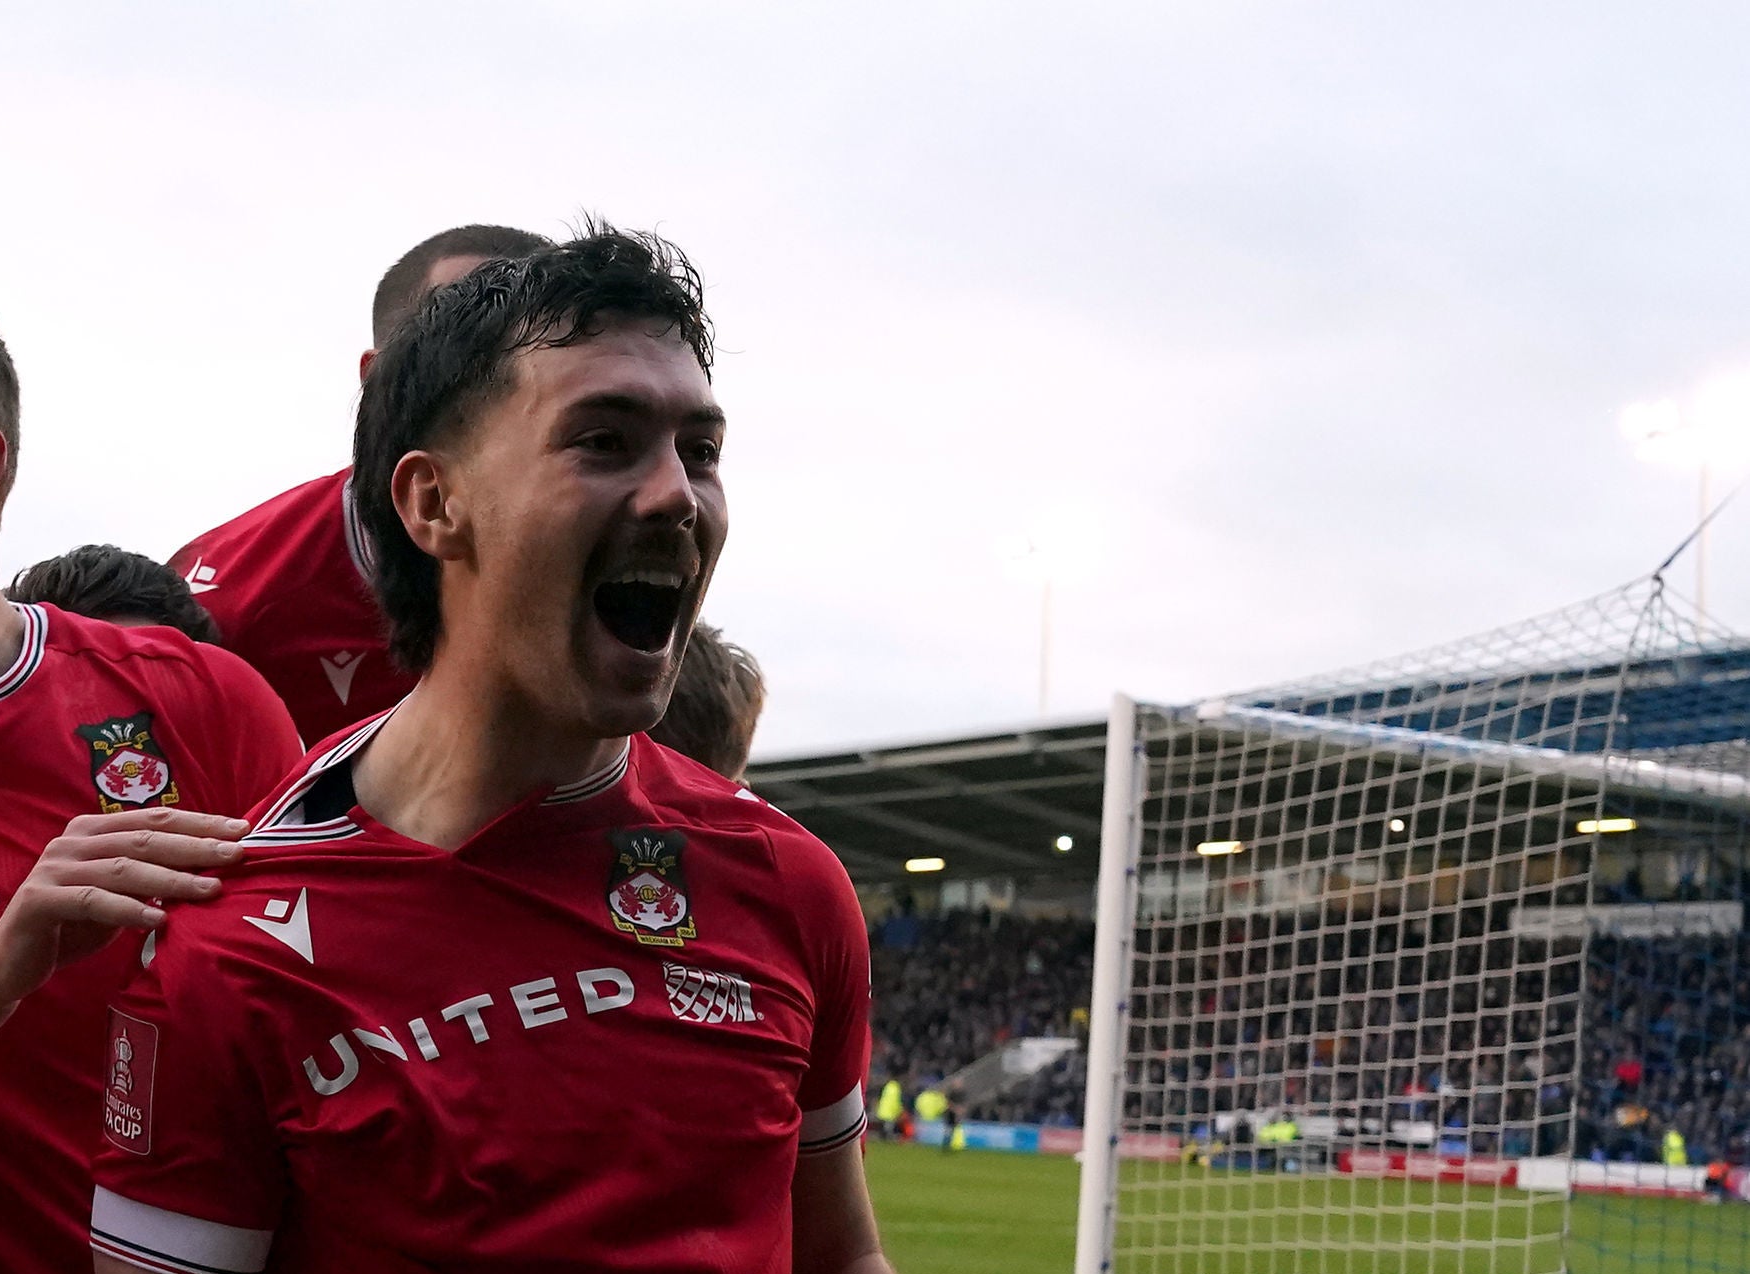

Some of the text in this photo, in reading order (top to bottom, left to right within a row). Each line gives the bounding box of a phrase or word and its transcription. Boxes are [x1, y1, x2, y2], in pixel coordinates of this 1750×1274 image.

[303, 967, 636, 1097] UNITED
[106, 1088, 142, 1121] Emirates
[113, 1114, 142, 1140] CUP
